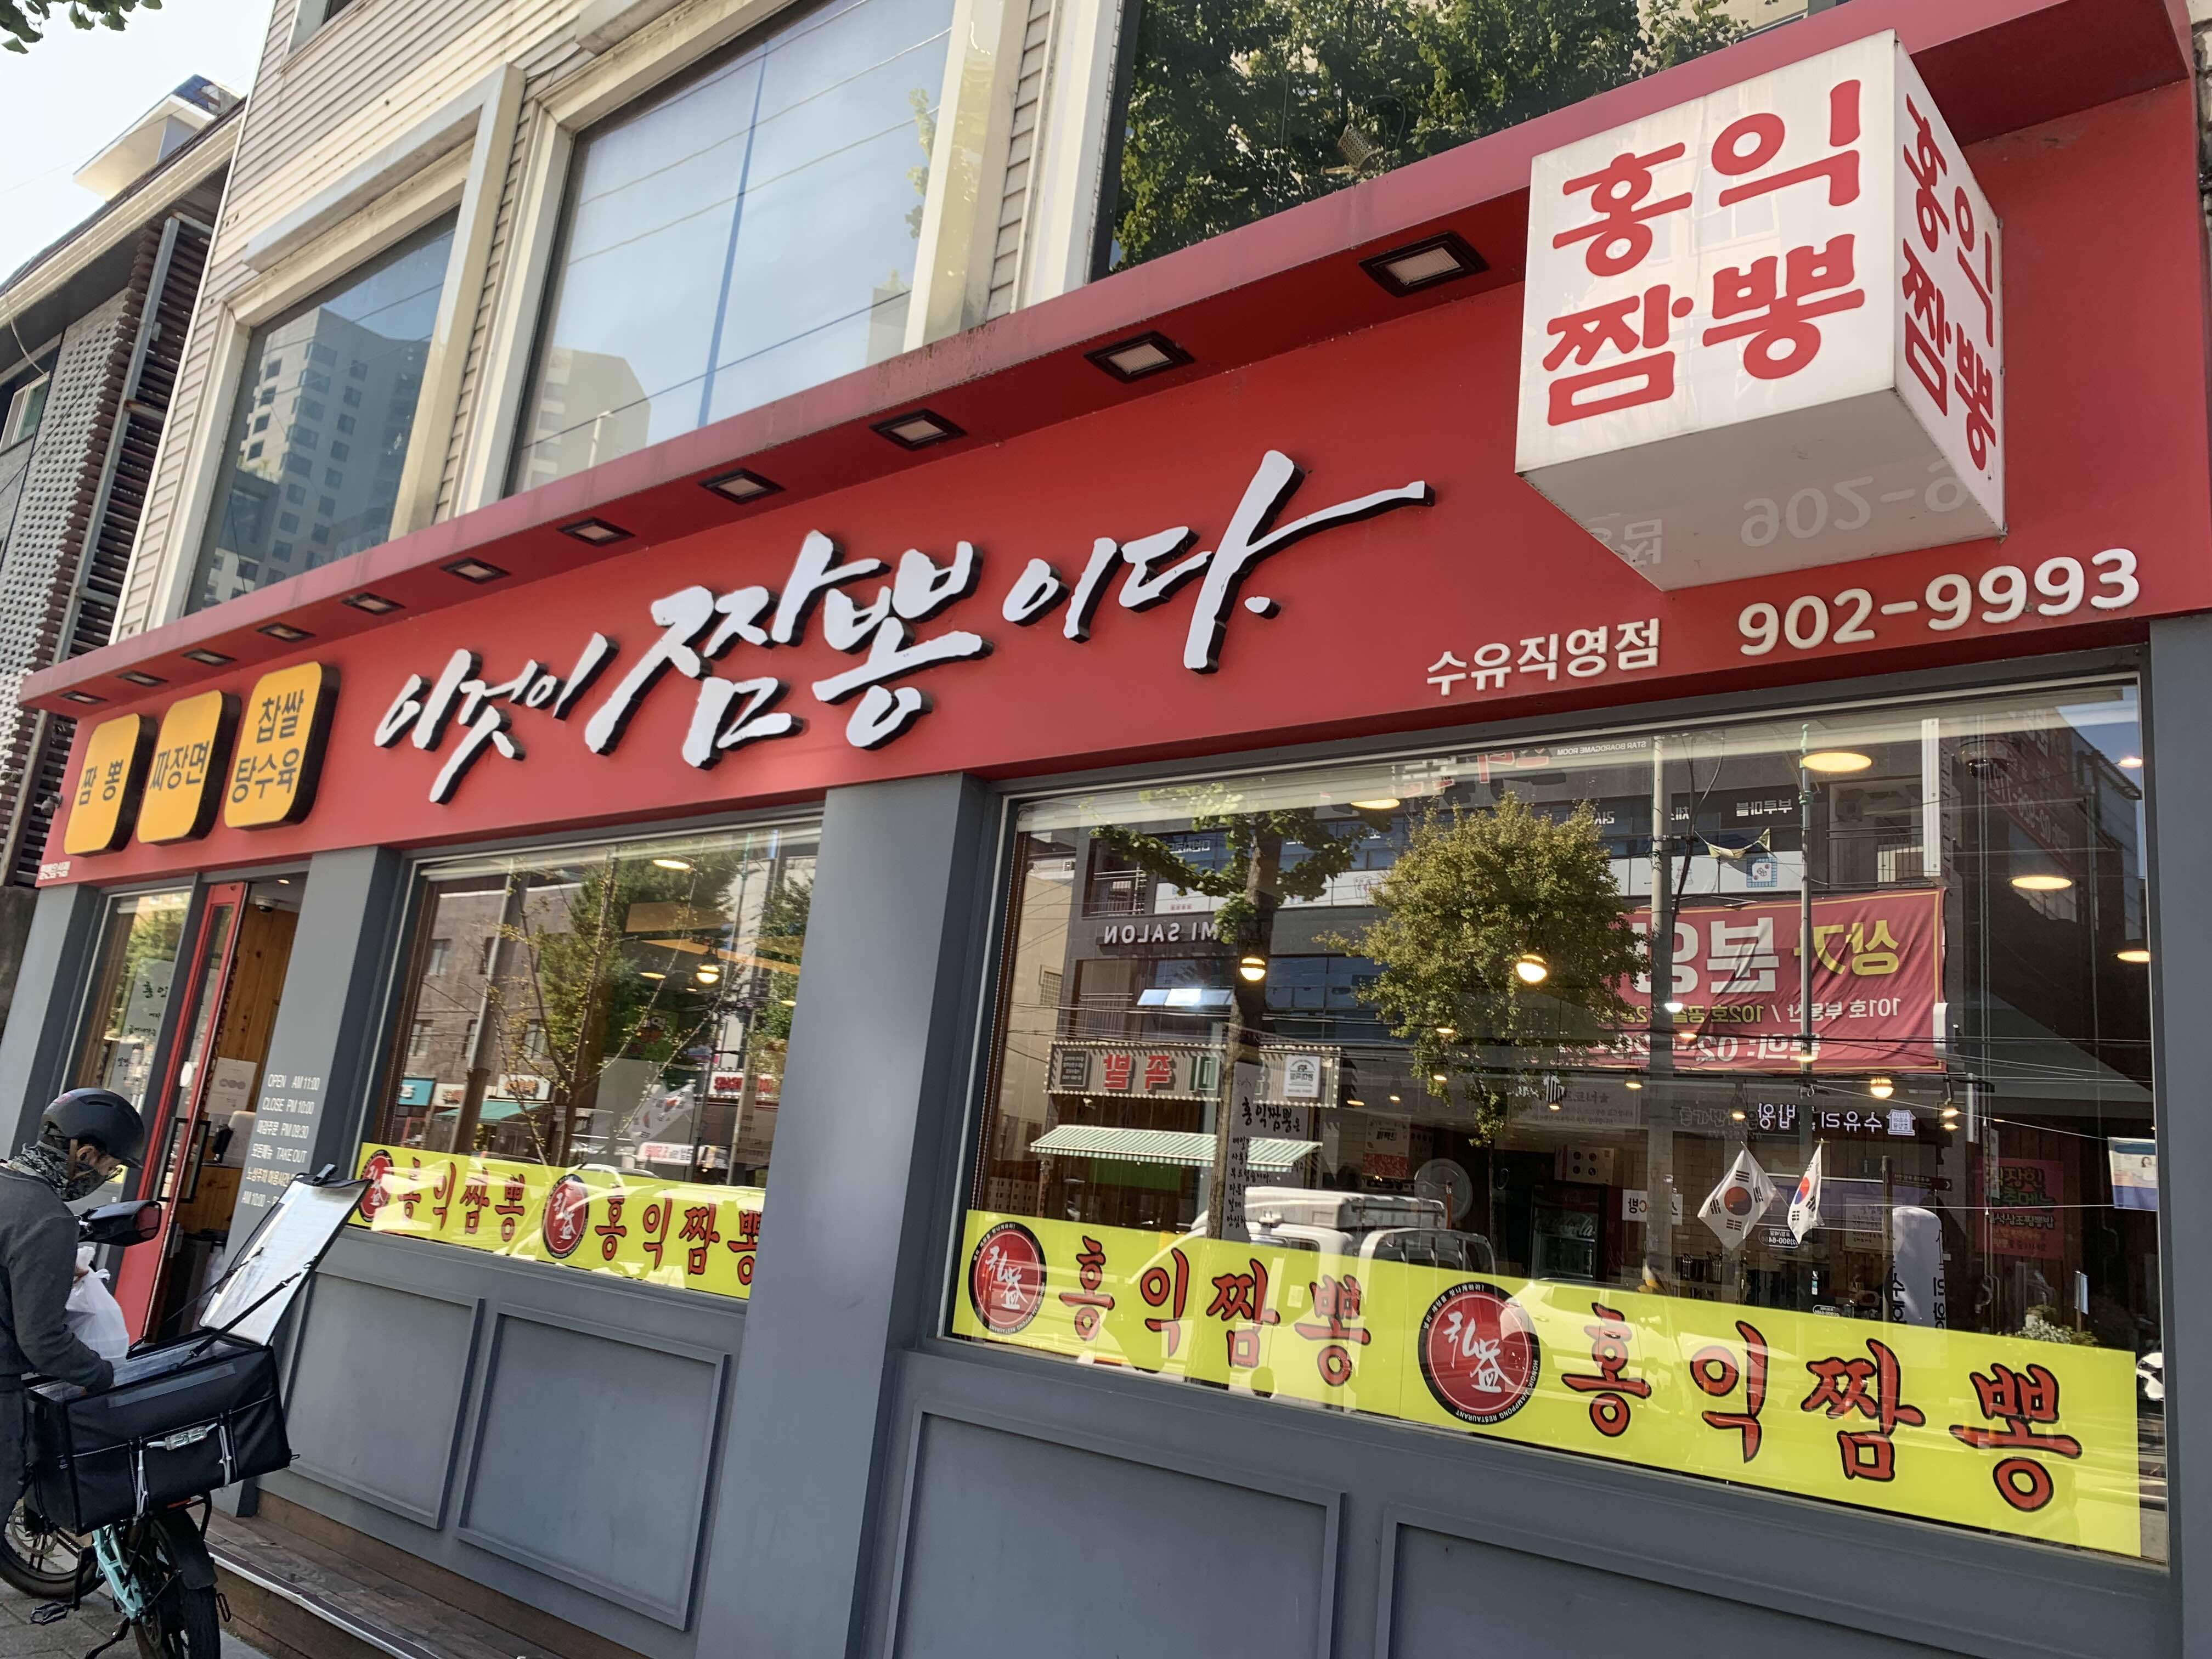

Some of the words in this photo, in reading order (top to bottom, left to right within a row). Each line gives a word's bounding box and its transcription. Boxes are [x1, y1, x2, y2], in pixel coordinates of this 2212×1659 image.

[1552, 79, 1861, 278] 홍익
[1903, 94, 1995, 348] 홍익
[1542, 233, 1865, 426] 짬뽕
[1901, 239, 1996, 472] 짬뽕
[1427, 617, 1661, 695] 수유직영점
[1737, 548, 2141, 656] 902-9993
[256, 689, 304, 744] 찹쌀
[375, 631, 619, 805] 이것이
[150, 740, 210, 792] 짜장면
[232, 748, 300, 804] 탕수육
[262, 1097, 285, 1113] CLOSE
[286, 1099, 297, 1113] PM
[298, 1101, 315, 1115] 10:00
[267, 1074, 287, 1089] OPEN
[291, 1075, 303, 1089] AM
[303, 1077, 321, 1091] 11:00
[280, 1122, 291, 1137] PM
[1241, 1096, 1301, 1133] 홍익짬뽕은
[276, 1147, 293, 1163] TAKE
[292, 1150, 308, 1164] OUT
[397, 1156, 526, 1243] 홍익짬뽕
[1058, 1235, 1371, 1388] 홍익짬뽕
[1527, 1359, 1539, 1389] HONGIK
[1455, 1408, 1498, 1423] RESTAURANT
[1561, 1301, 2083, 1512] 홍익짬뽕
